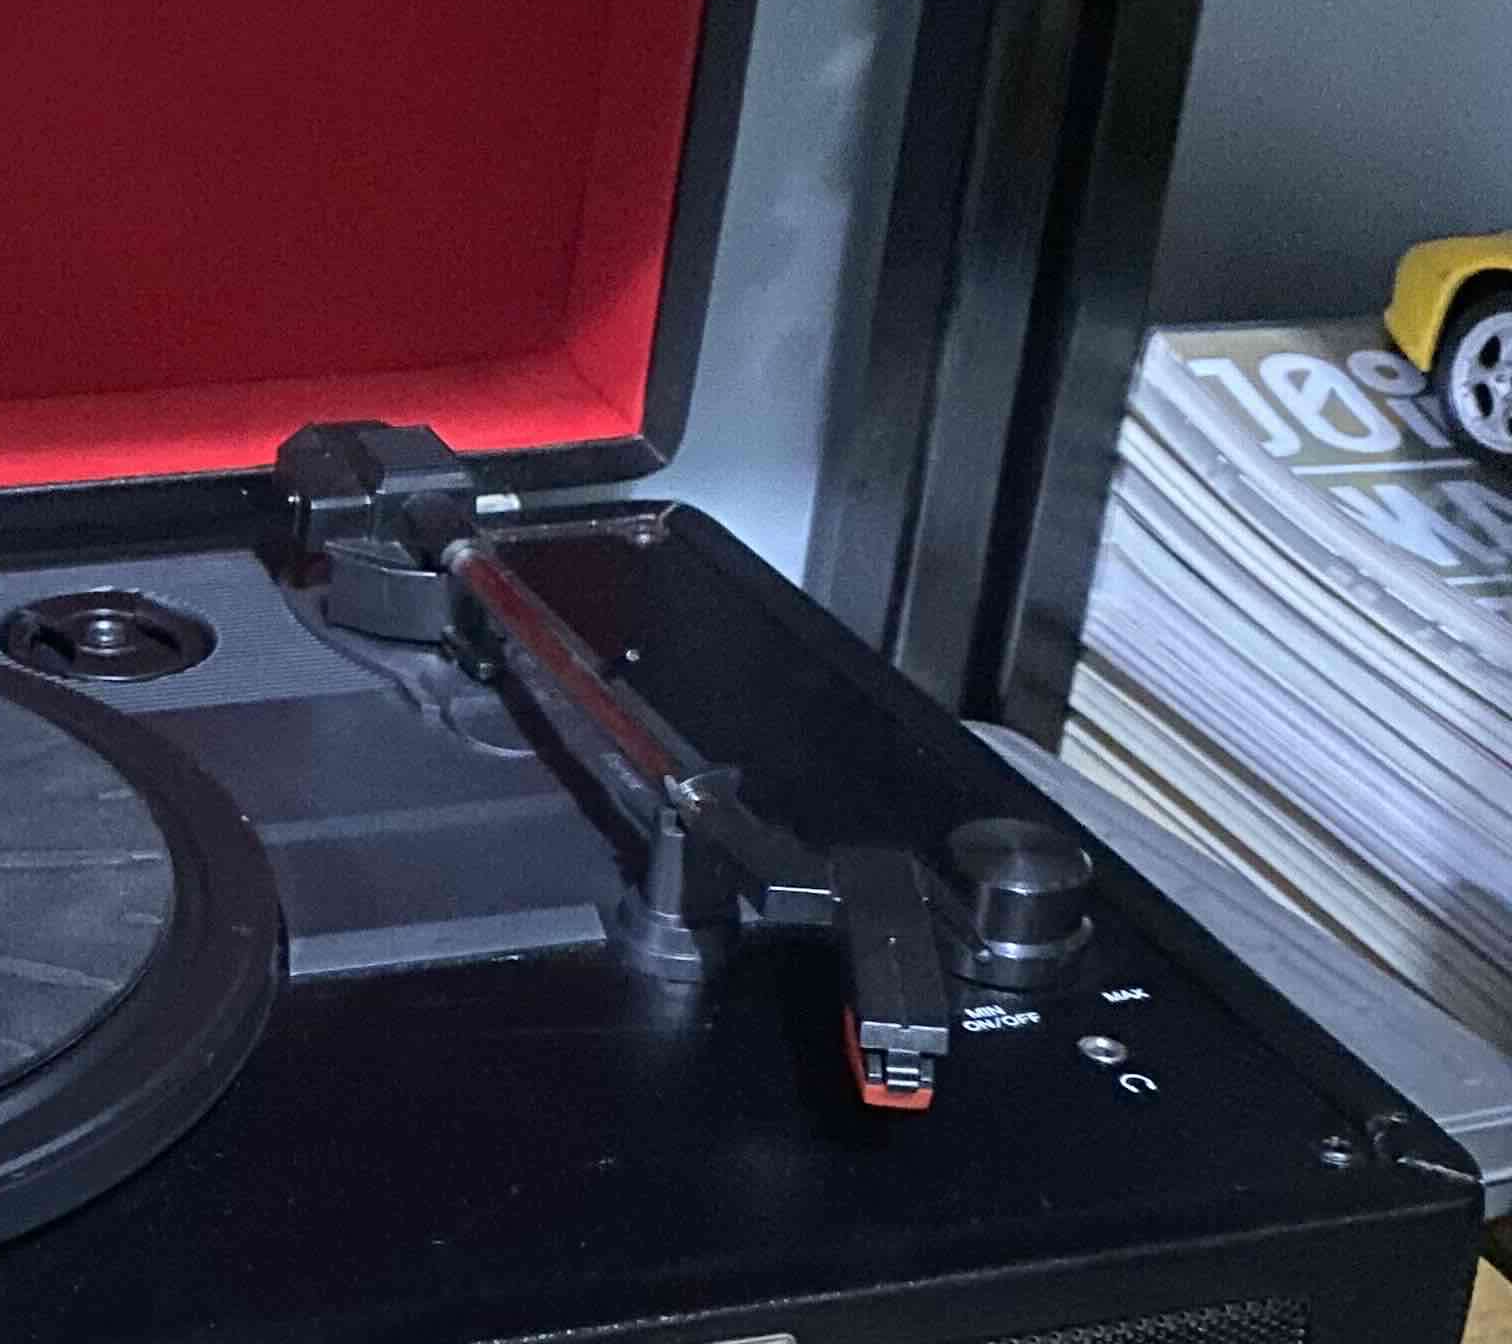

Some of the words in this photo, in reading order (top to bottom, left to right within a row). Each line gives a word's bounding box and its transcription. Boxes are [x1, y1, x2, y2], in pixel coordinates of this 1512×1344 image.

[1101, 987, 1152, 1004] MAX
[964, 1004, 1006, 1020] MIN
[961, 1011, 1041, 1033] ON/OFF
